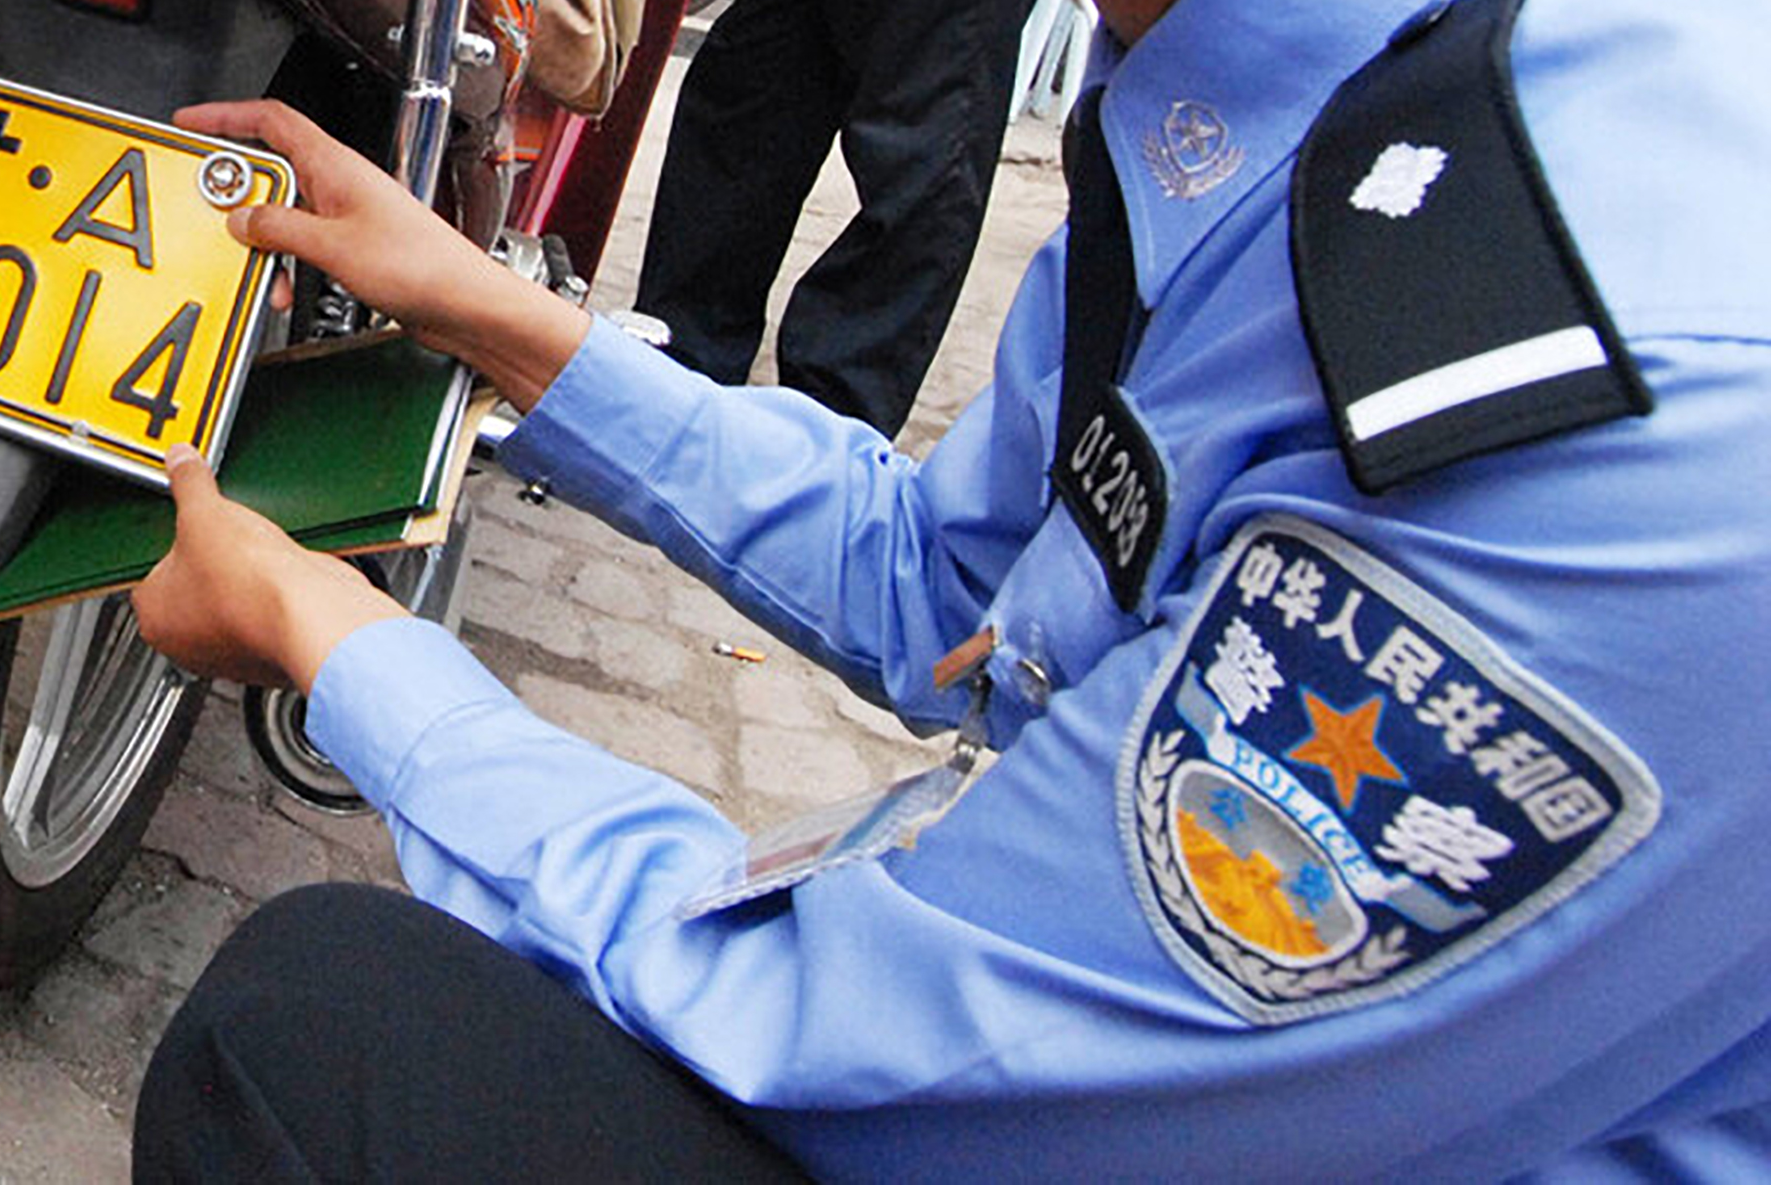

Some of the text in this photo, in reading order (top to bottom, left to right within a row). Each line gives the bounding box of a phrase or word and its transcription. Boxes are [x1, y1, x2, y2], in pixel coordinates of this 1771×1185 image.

[1237, 543, 1612, 843] 中华人民共和国
[1233, 739, 1370, 874] POLICE
